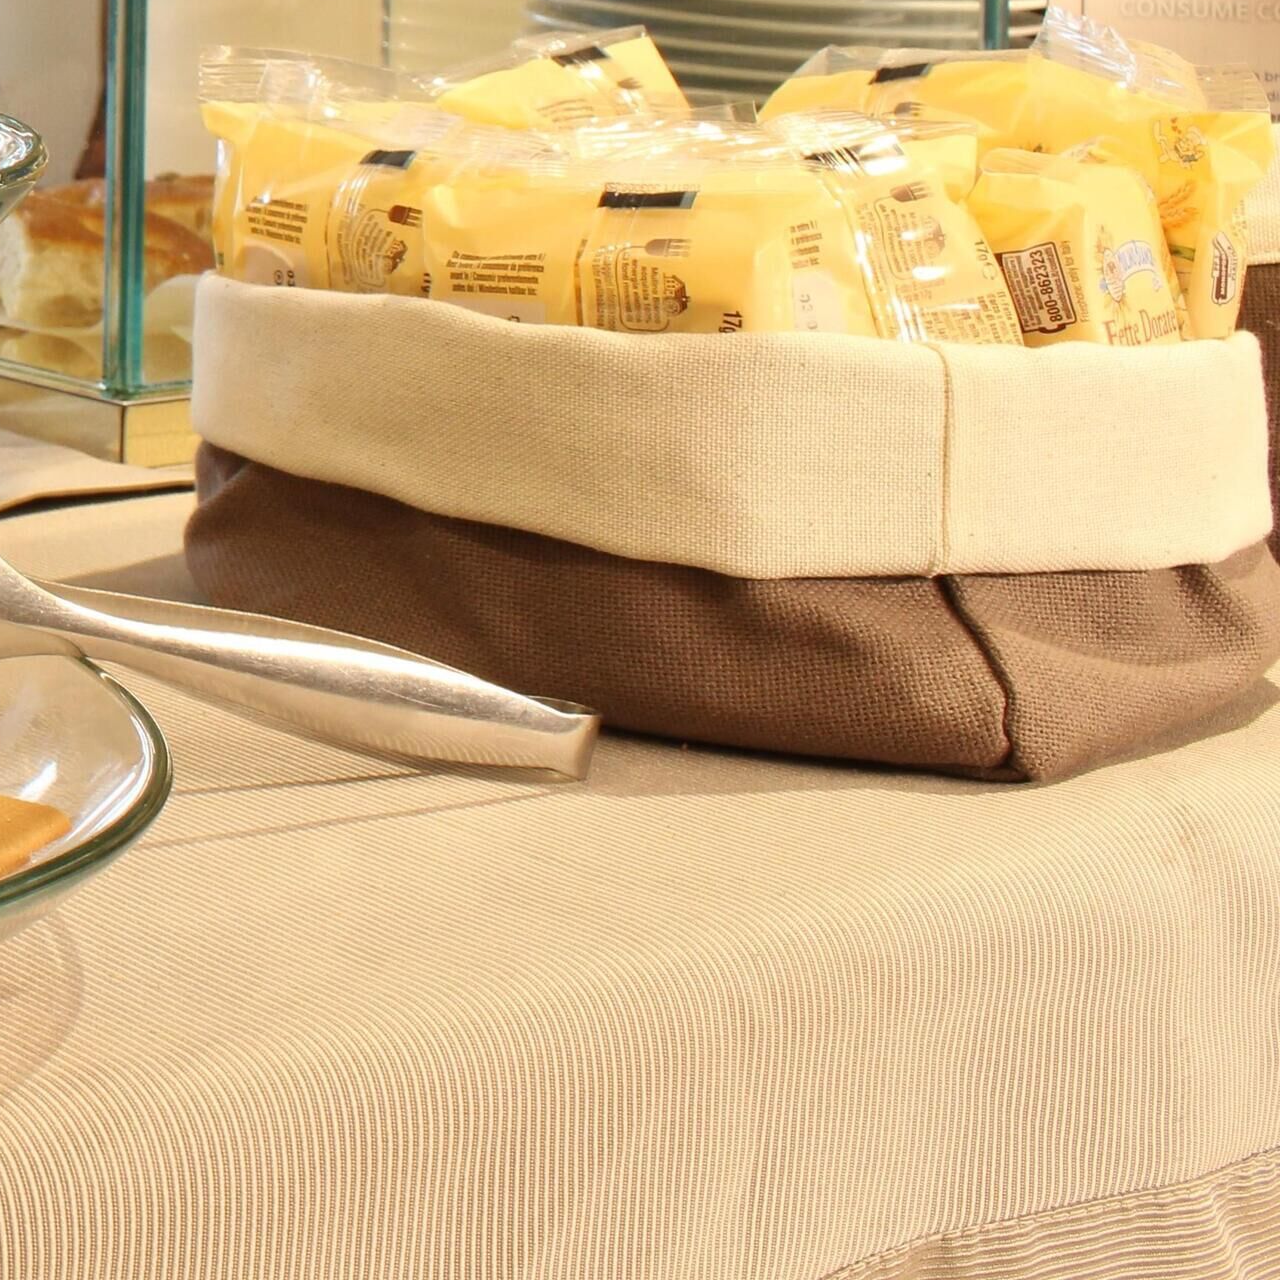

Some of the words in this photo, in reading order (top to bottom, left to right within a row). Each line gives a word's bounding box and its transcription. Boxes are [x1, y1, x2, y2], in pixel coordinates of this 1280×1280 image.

[1119, 0, 1249, 20] CONSUME
[1029, 249, 1063, 323] 800-862323
[719, 310, 743, 333] 17g
